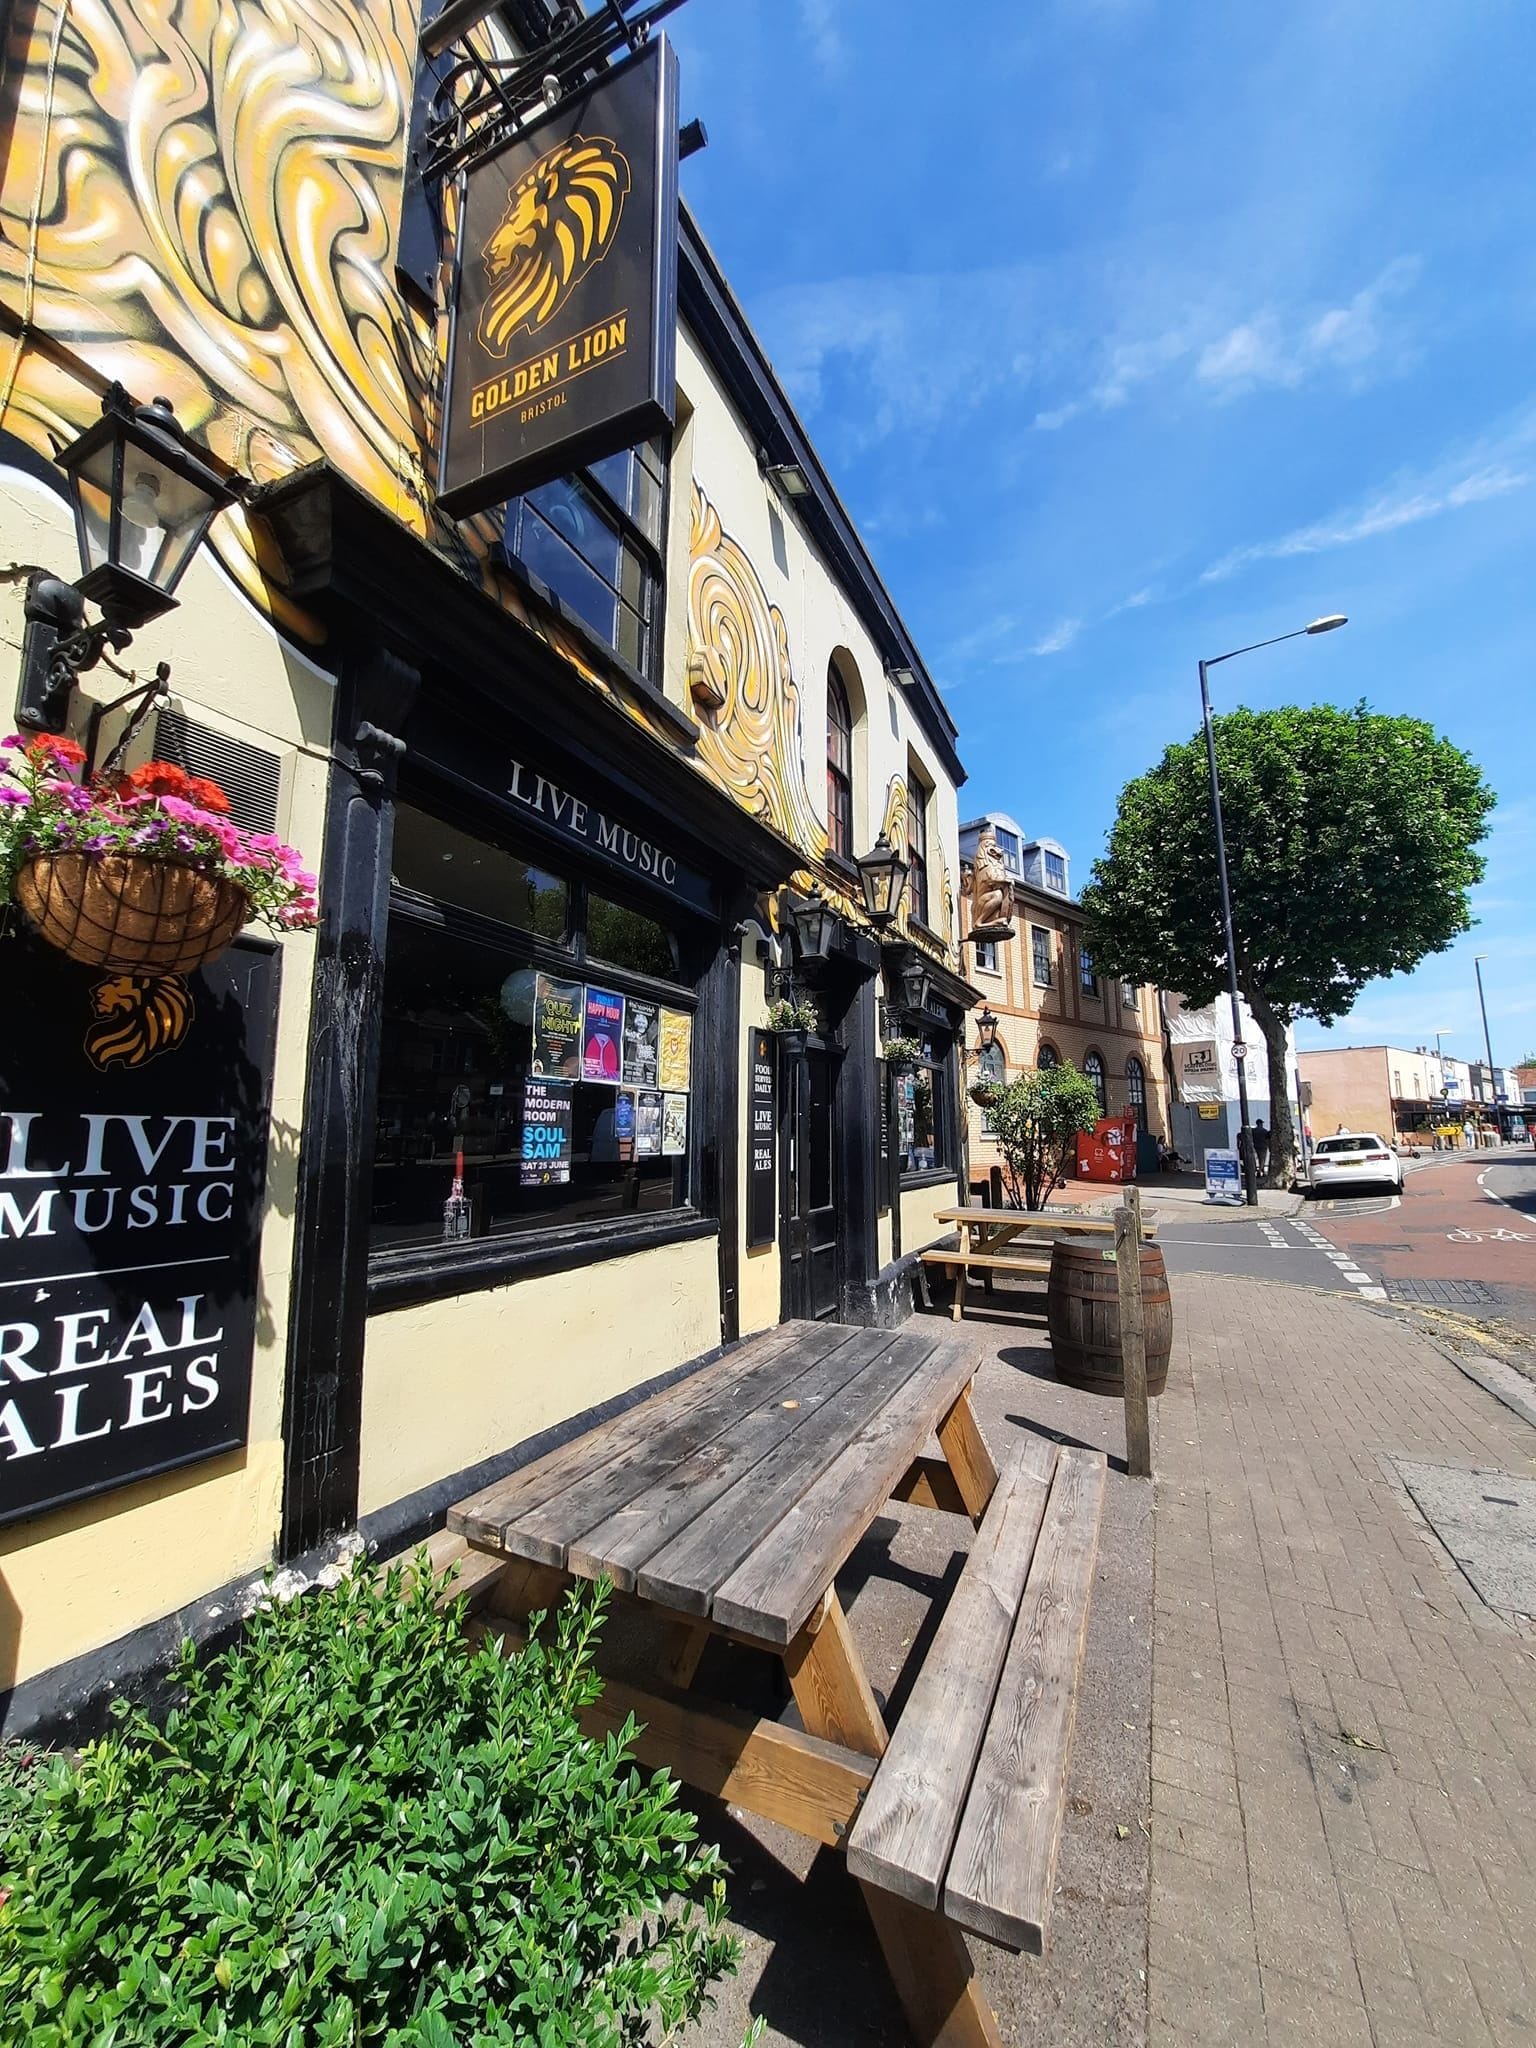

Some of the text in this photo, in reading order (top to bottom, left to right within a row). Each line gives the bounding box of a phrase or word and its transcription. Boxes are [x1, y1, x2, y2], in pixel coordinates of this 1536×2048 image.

[471, 317, 627, 418] GOLDEN LION
[520, 391, 568, 424] BRISTOL
[507, 759, 677, 886] LIVE MUSIC
[587, 1001, 605, 1016] HAPPY
[605, 1006, 620, 1020] HOUR
[1233, 1046, 1245, 1055] 20
[525, 1085, 547, 1096] THE
[754, 1083, 772, 1093] DAILY
[524, 1097, 571, 1111] MODERN
[523, 1111, 557, 1122] ROOM
[754, 1110, 772, 1122] LIVE
[754, 1122, 772, 1131] MUSIC
[523, 1126, 567, 1143] SOUL
[0, 1111, 236, 1179] LIVE
[521, 1143, 561, 1160] SAM
[754, 1148, 772, 1160] REAL
[521, 1160, 570, 1171] SAT 25 JUNE
[754, 1160, 772, 1171] ALES
[0, 1181, 234, 1239] MUSIC
[0, 1294, 224, 1387] REAL
[0, 1352, 220, 1461] ALES
